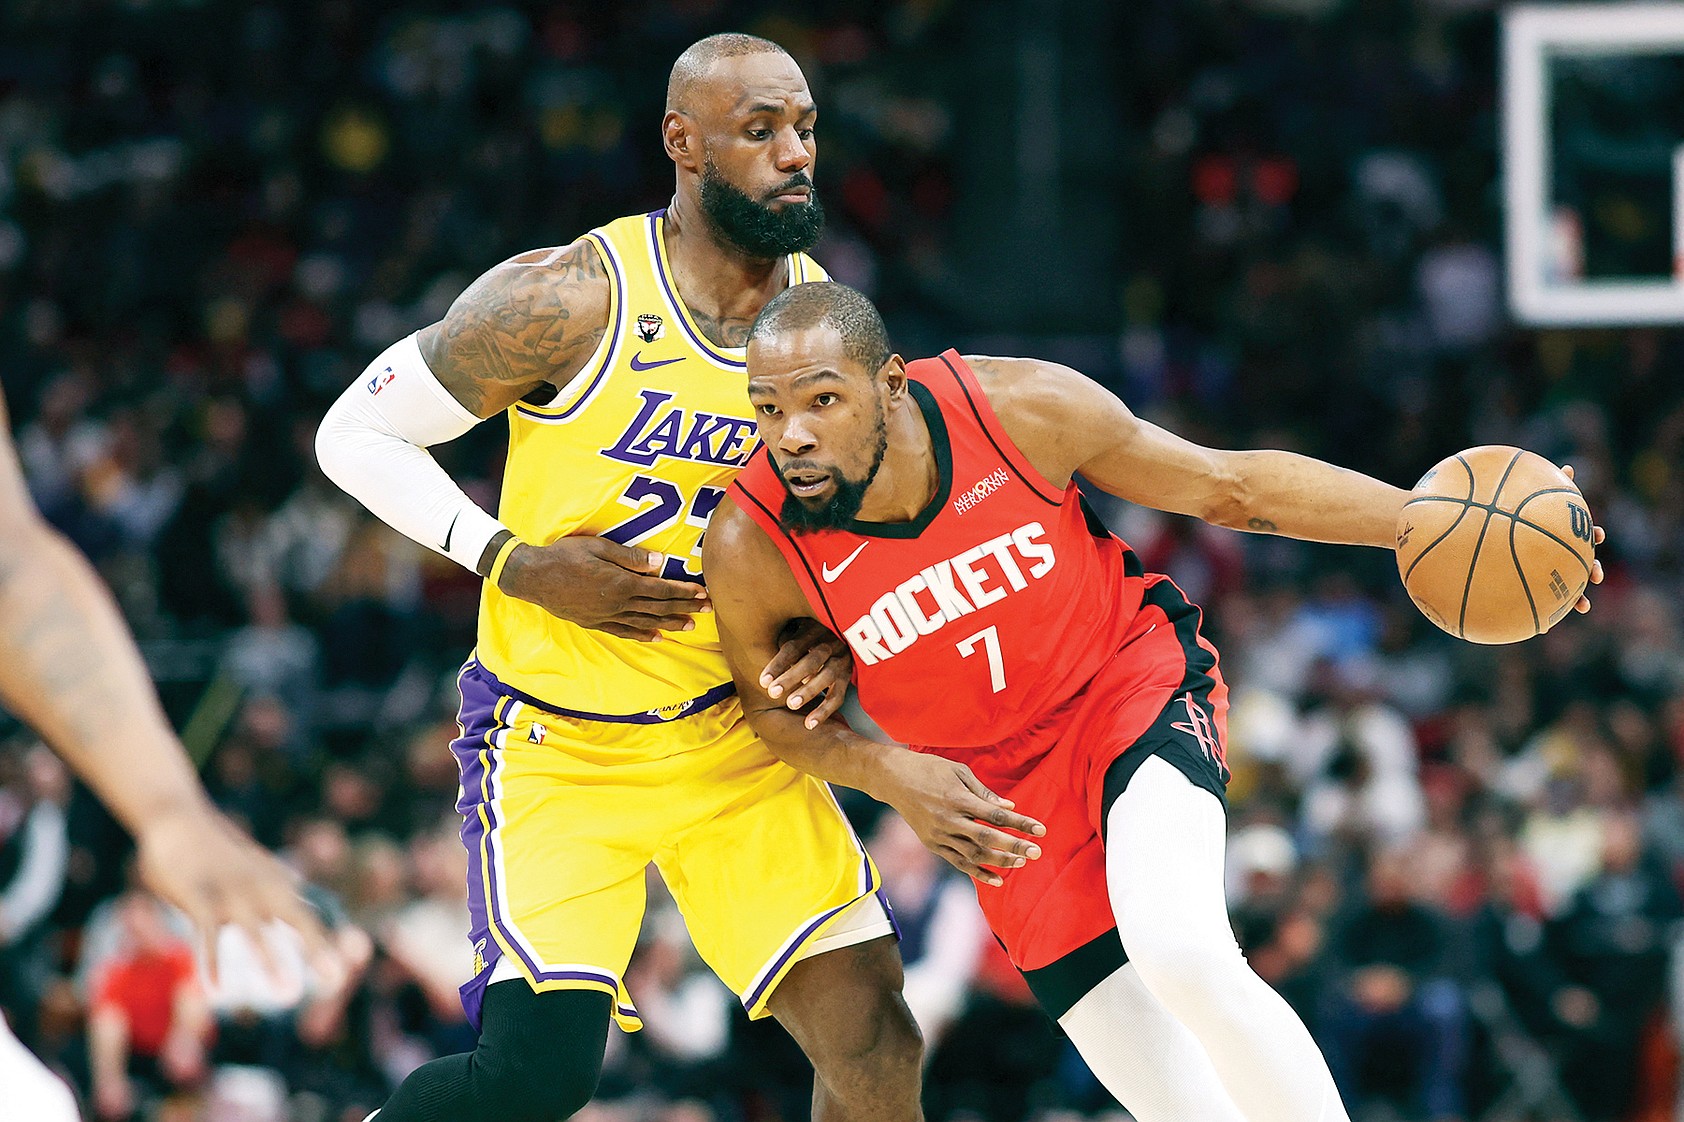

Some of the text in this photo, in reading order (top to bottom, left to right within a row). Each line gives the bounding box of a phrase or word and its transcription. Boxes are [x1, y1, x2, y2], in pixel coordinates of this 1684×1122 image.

[600, 389, 767, 468] LAKE
[953, 467, 1007, 509] MEMORIAL
[956, 471, 1010, 516] HERMANN
[843, 521, 1056, 666] ROCKETS
[955, 624, 1007, 694] 7
